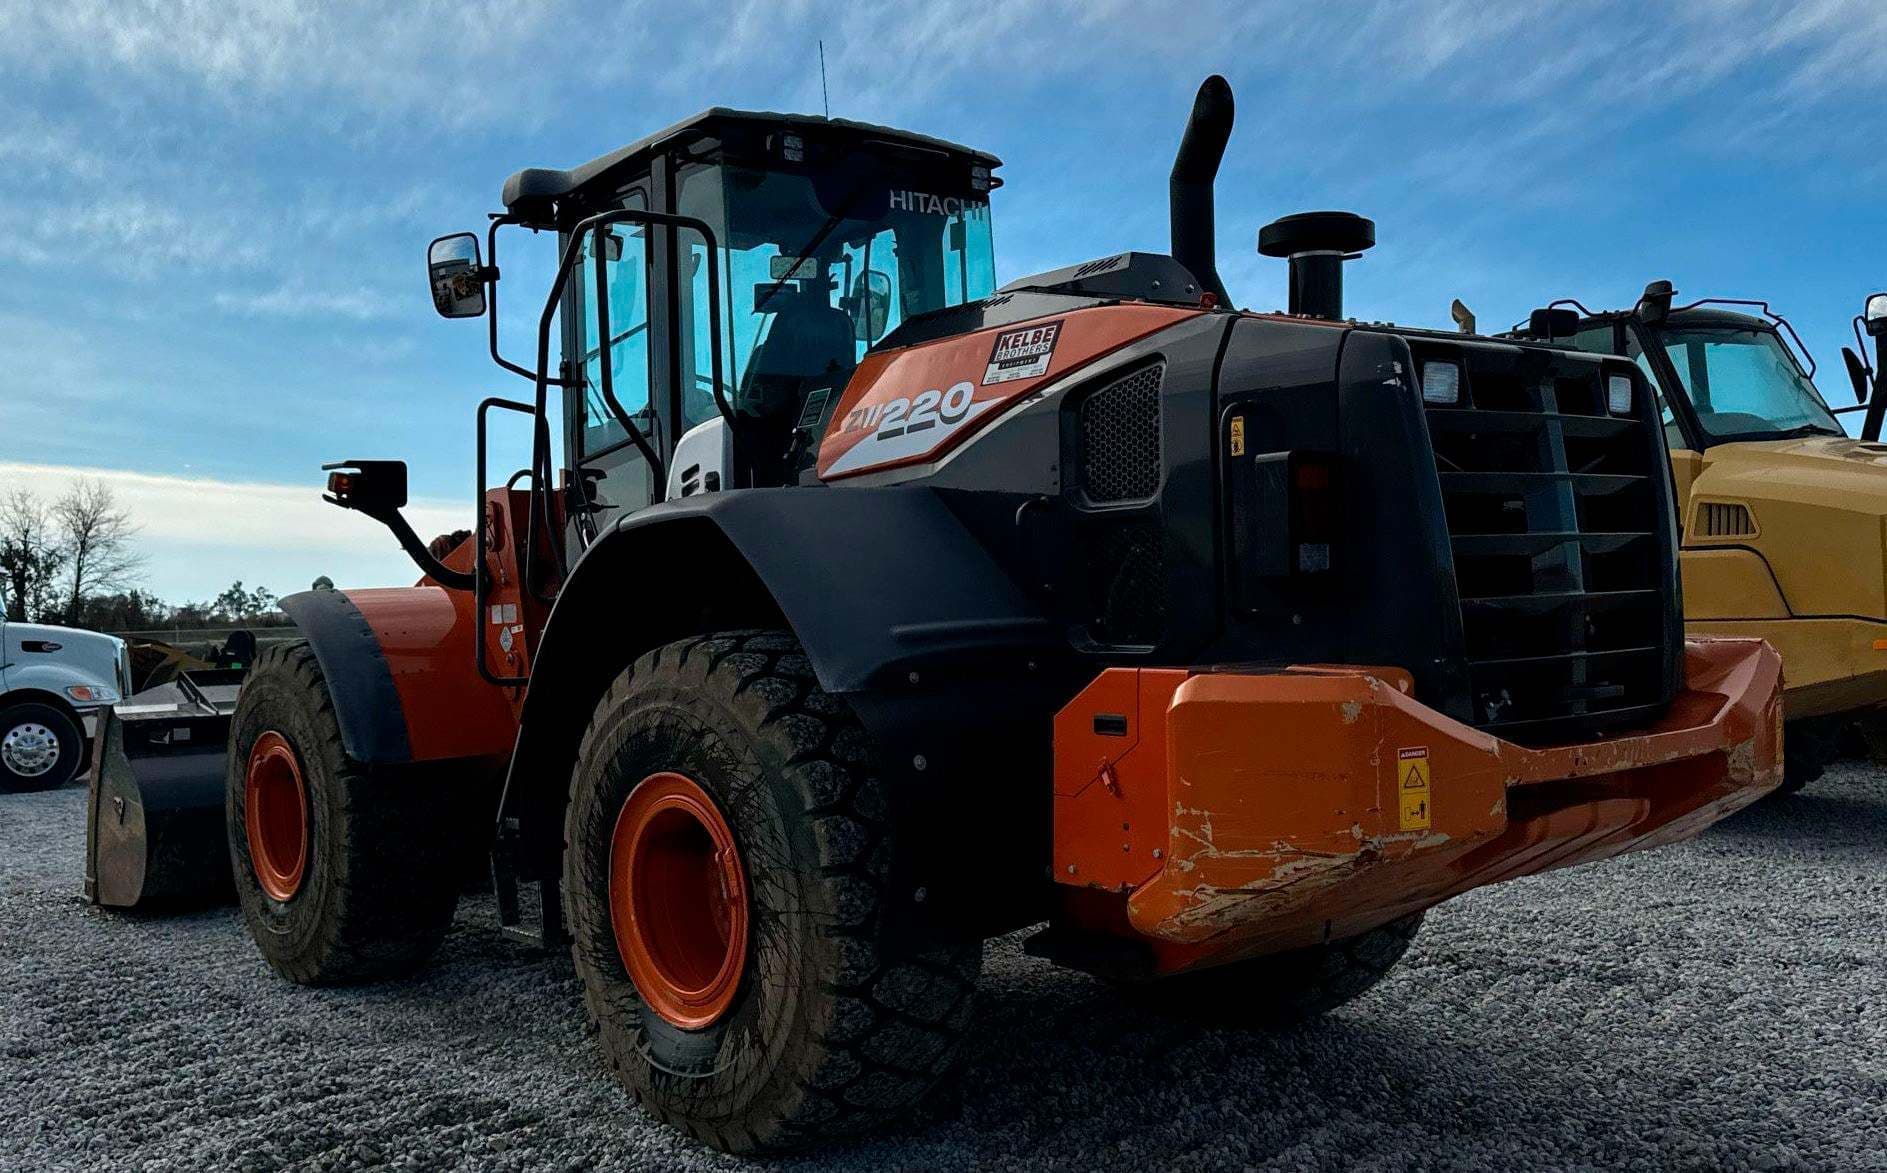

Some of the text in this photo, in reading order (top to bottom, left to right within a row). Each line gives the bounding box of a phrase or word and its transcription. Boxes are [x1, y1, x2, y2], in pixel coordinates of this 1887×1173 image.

[889, 189, 984, 221] HITACHI
[996, 342, 1049, 360] BROTHERS
[1000, 327, 1054, 351] KELBE
[844, 381, 974, 434] ZW220
